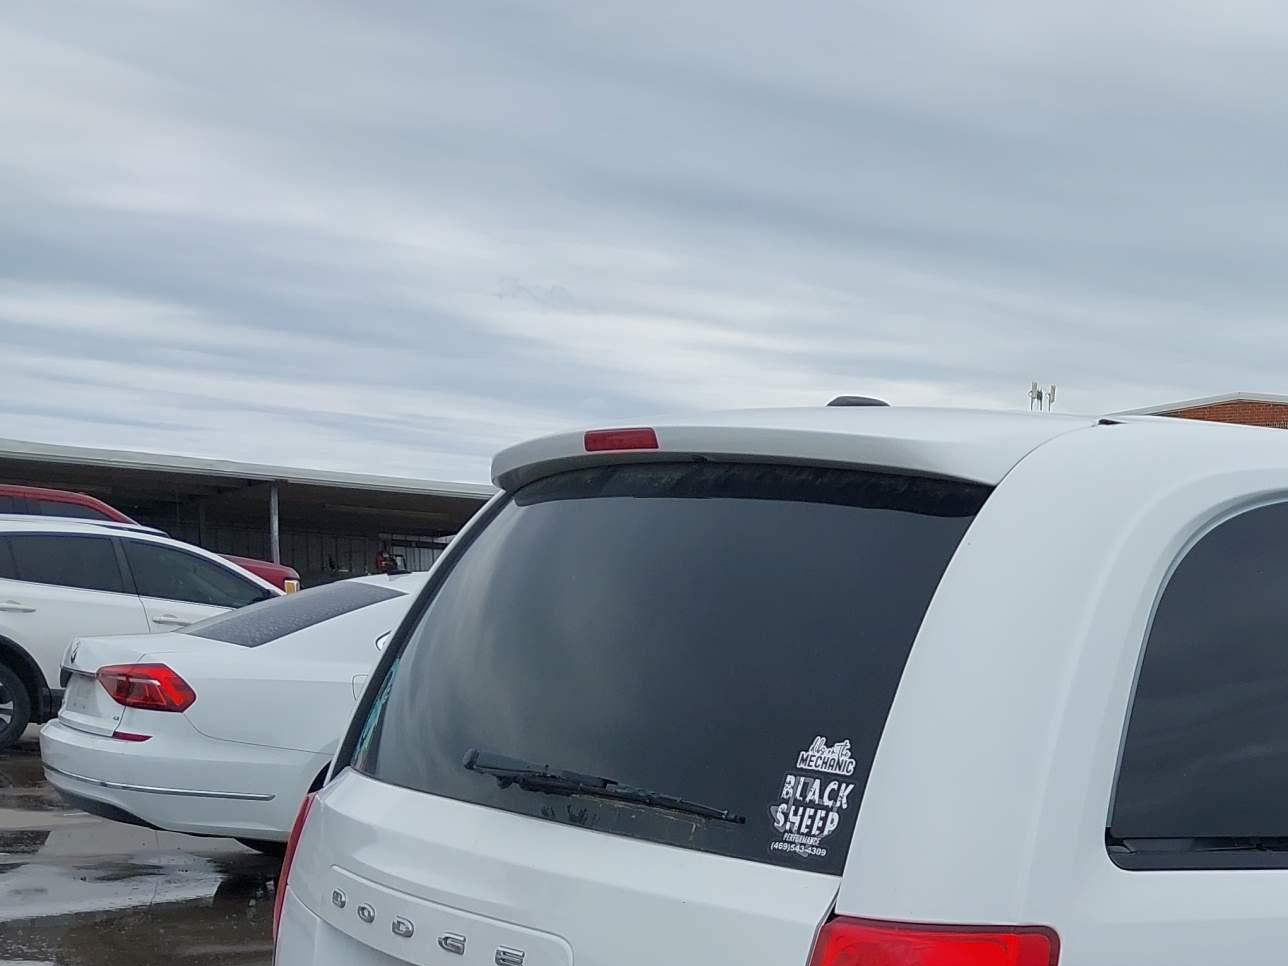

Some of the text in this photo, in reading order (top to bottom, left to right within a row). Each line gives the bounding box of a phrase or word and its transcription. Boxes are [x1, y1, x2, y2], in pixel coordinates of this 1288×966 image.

[798, 751, 855, 775] MECHANIC
[781, 774, 855, 809] BLACK
[774, 803, 839, 836] SHEEP
